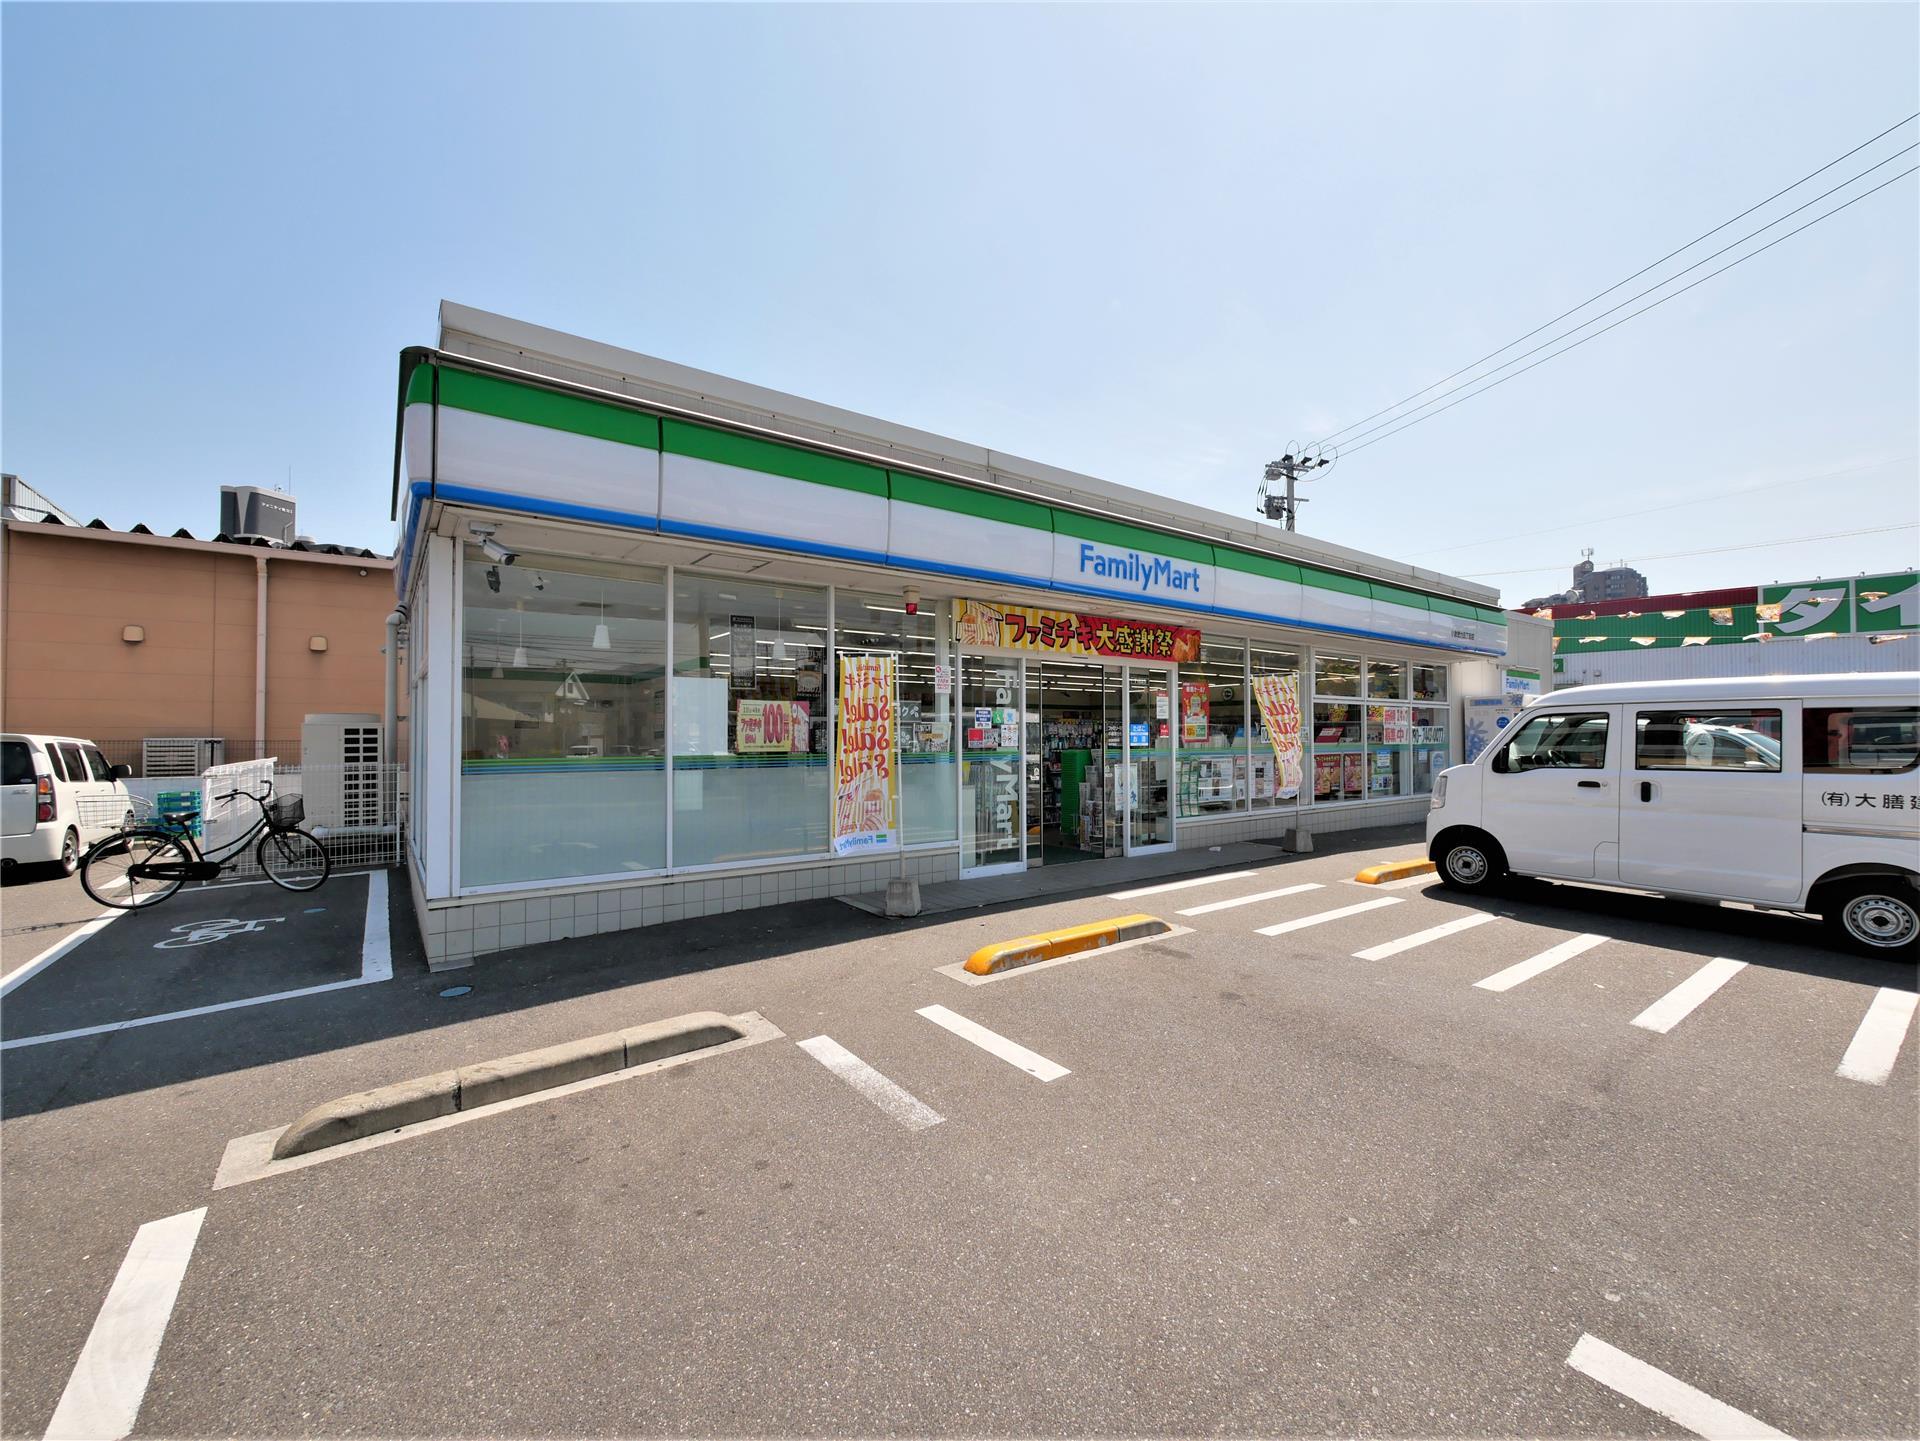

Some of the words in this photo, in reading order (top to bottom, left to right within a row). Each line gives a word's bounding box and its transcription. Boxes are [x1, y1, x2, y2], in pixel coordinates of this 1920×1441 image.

[1080, 543, 1200, 592] FamilyMart
[1004, 614, 1174, 657] ファミチキ大感謝祭
[990, 669, 1018, 849] FayMart
